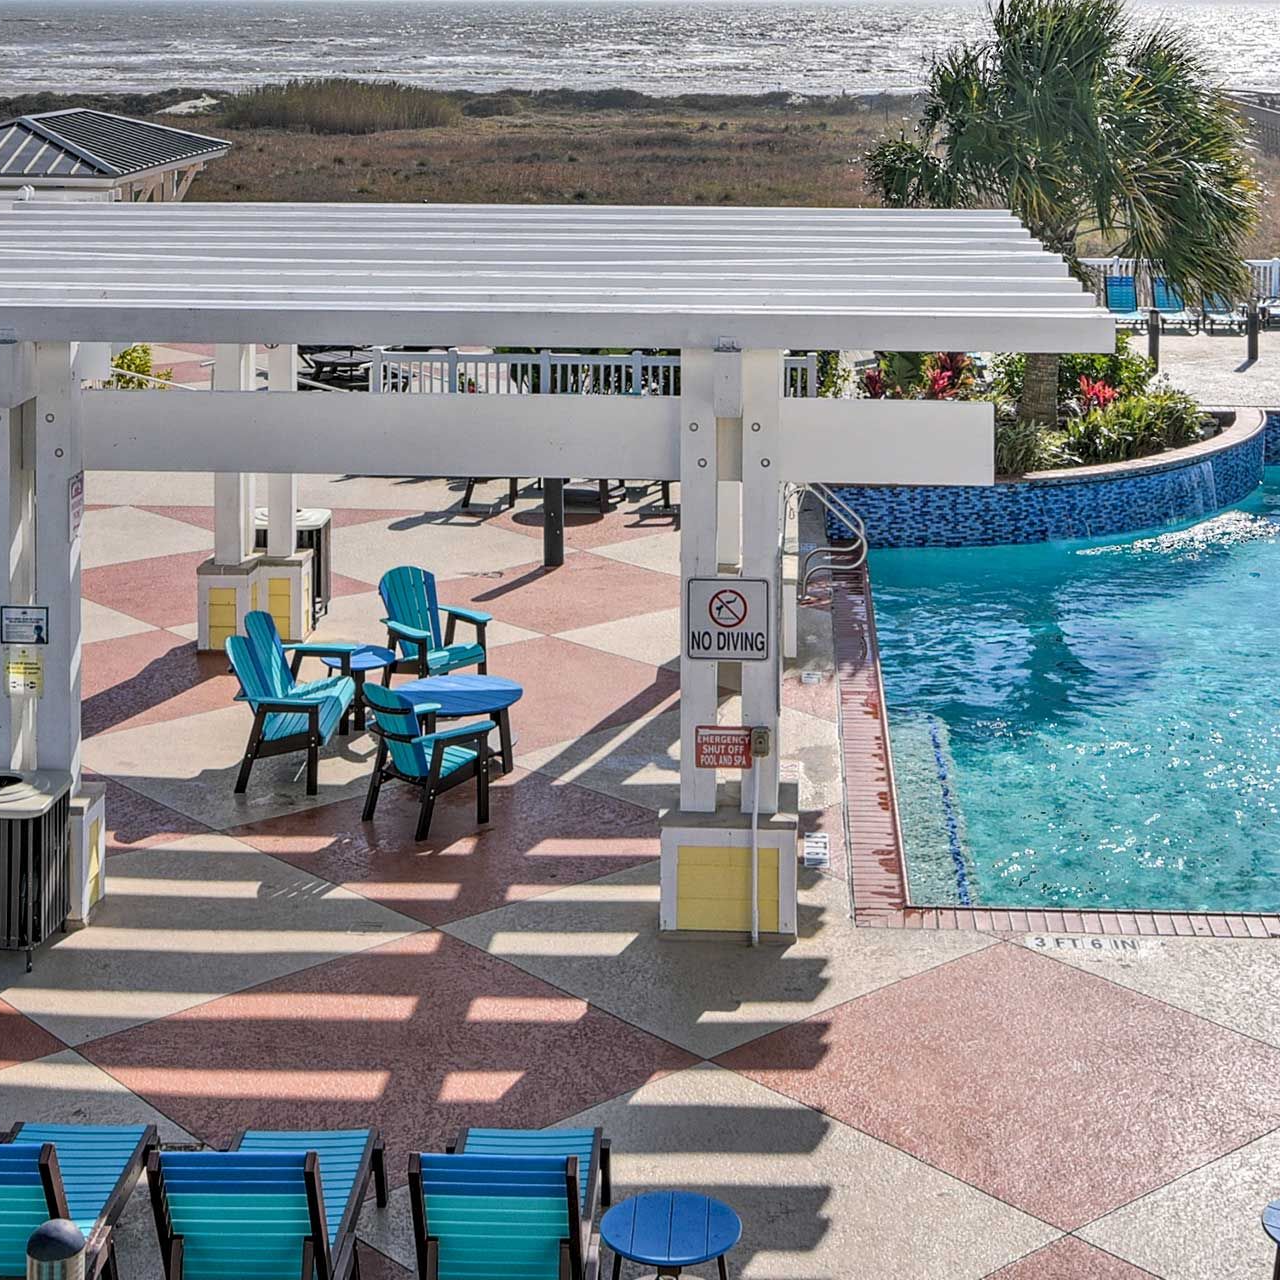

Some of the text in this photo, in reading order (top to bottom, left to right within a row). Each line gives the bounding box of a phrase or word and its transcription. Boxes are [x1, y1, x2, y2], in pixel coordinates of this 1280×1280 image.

[691, 631, 765, 651] NO DIVING
[697, 735, 750, 744] EMERGENCY
[702, 744, 745, 754] SHUT OFF
[700, 754, 747, 766] POOL AND SPA
[1034, 937, 1137, 950] 3 FT 6 IN
